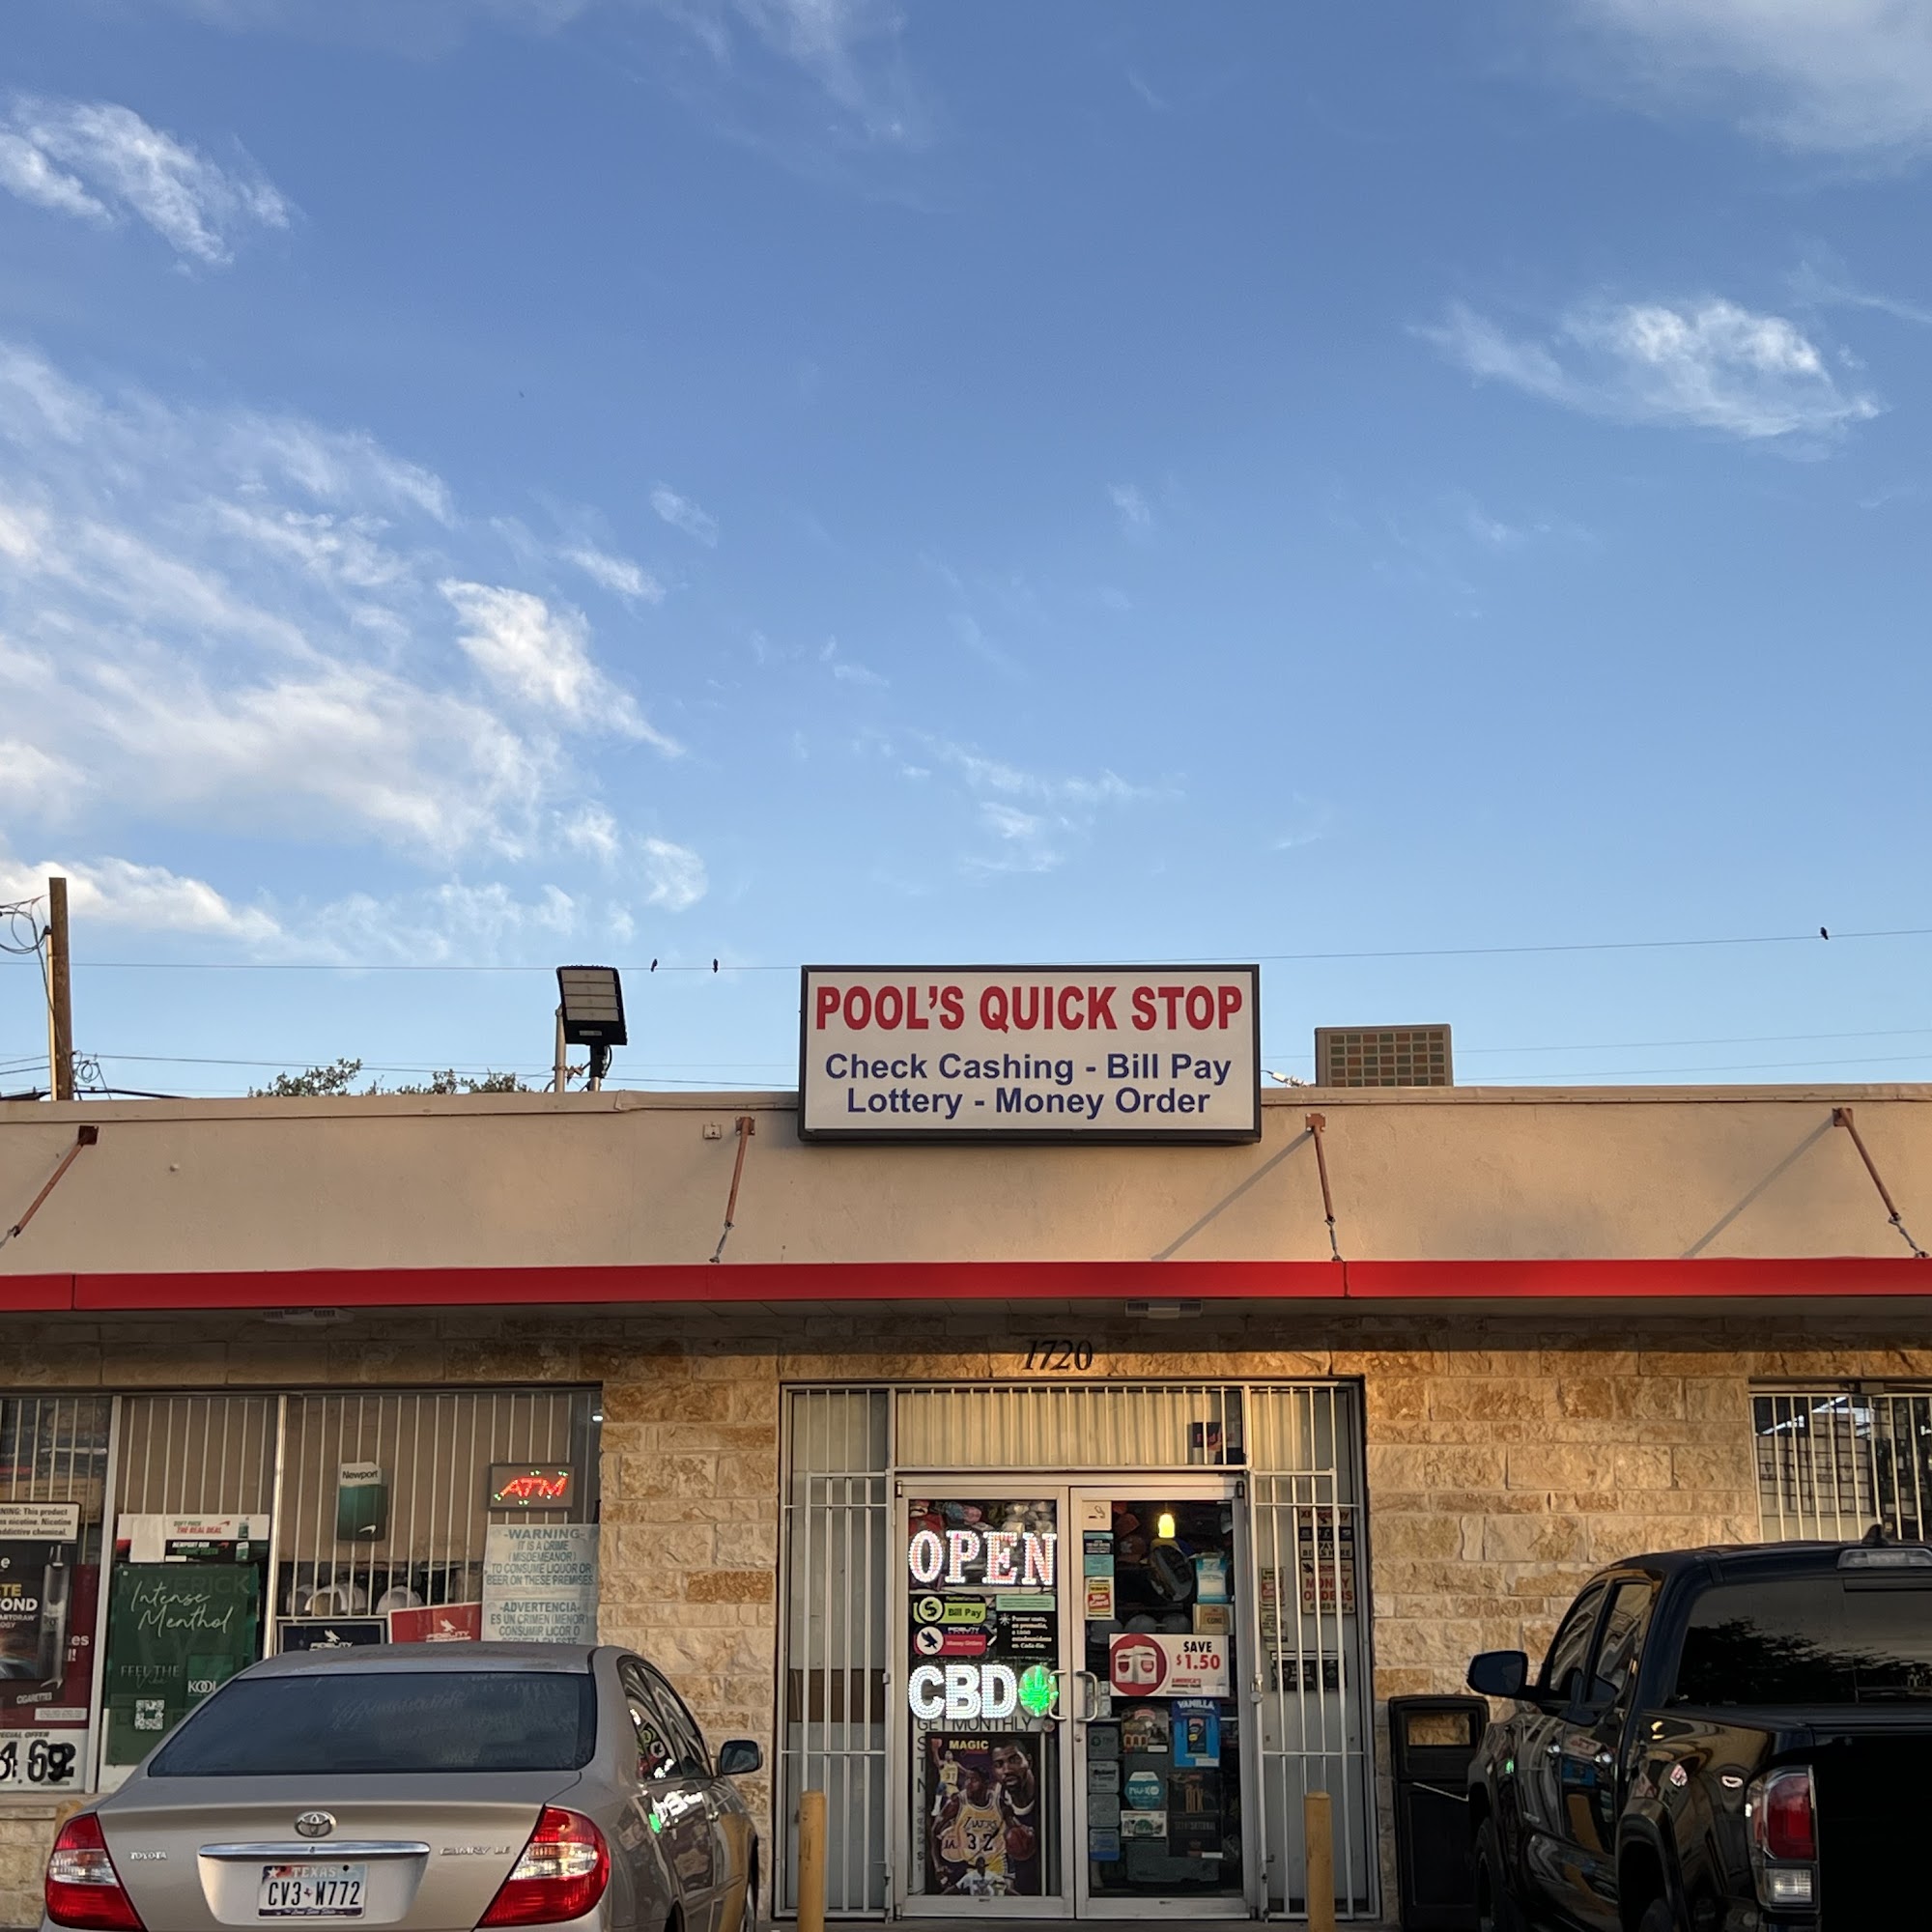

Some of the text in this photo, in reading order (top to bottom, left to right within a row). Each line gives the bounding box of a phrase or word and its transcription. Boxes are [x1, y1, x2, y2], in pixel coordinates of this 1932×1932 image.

[816, 984, 1243, 1034] POOL'S QUICK STOP
[825, 1053, 927, 1080] Check
[939, 1053, 1073, 1086] Cashing
[1107, 1053, 1159, 1079] Bill
[1172, 1053, 1232, 1086] Pay
[847, 1088, 962, 1120] Lottery
[996, 1088, 1104, 1120] Money
[1115, 1088, 1210, 1114] Order
[1021, 1340, 1094, 1371] 1720
[342, 1470, 379, 1480] Newport
[499, 1476, 568, 1497] ATM
[40, 1508, 68, 1517] product
[908, 1529, 1058, 1586] OPEN
[492, 1563, 592, 1574] TO CONSUME LIQUOR OR
[486, 1575, 509, 1585] BEER
[510, 1575, 523, 1585] ON
[525, 1575, 552, 1585] THESE
[0, 1583, 22, 1597] TE
[130, 1580, 212, 1612] Intense
[0, 1597, 39, 1612] OND
[490, 1614, 502, 1625] ES
[503, 1614, 516, 1625] UN
[517, 1614, 551, 1625] CRIMEN
[948, 1607, 981, 1619] Bill Pay
[137, 1604, 234, 1638] Menthol
[498, 1626, 581, 1636] CONSUMIR LICOR O
[1183, 1640, 1212, 1653] SAVE
[1176, 1654, 1221, 1670] $1.50
[908, 1664, 1017, 1719] CBD
[1177, 1699, 1215, 1710] VANILLA
[918, 1716, 1032, 1731] GET MONTHLY
[949, 1740, 989, 1750] MAGIC
[129, 1851, 167, 1861] TOYOTA
[292, 1866, 337, 1878] TEXAS
[268, 1881, 301, 1906] CV3
